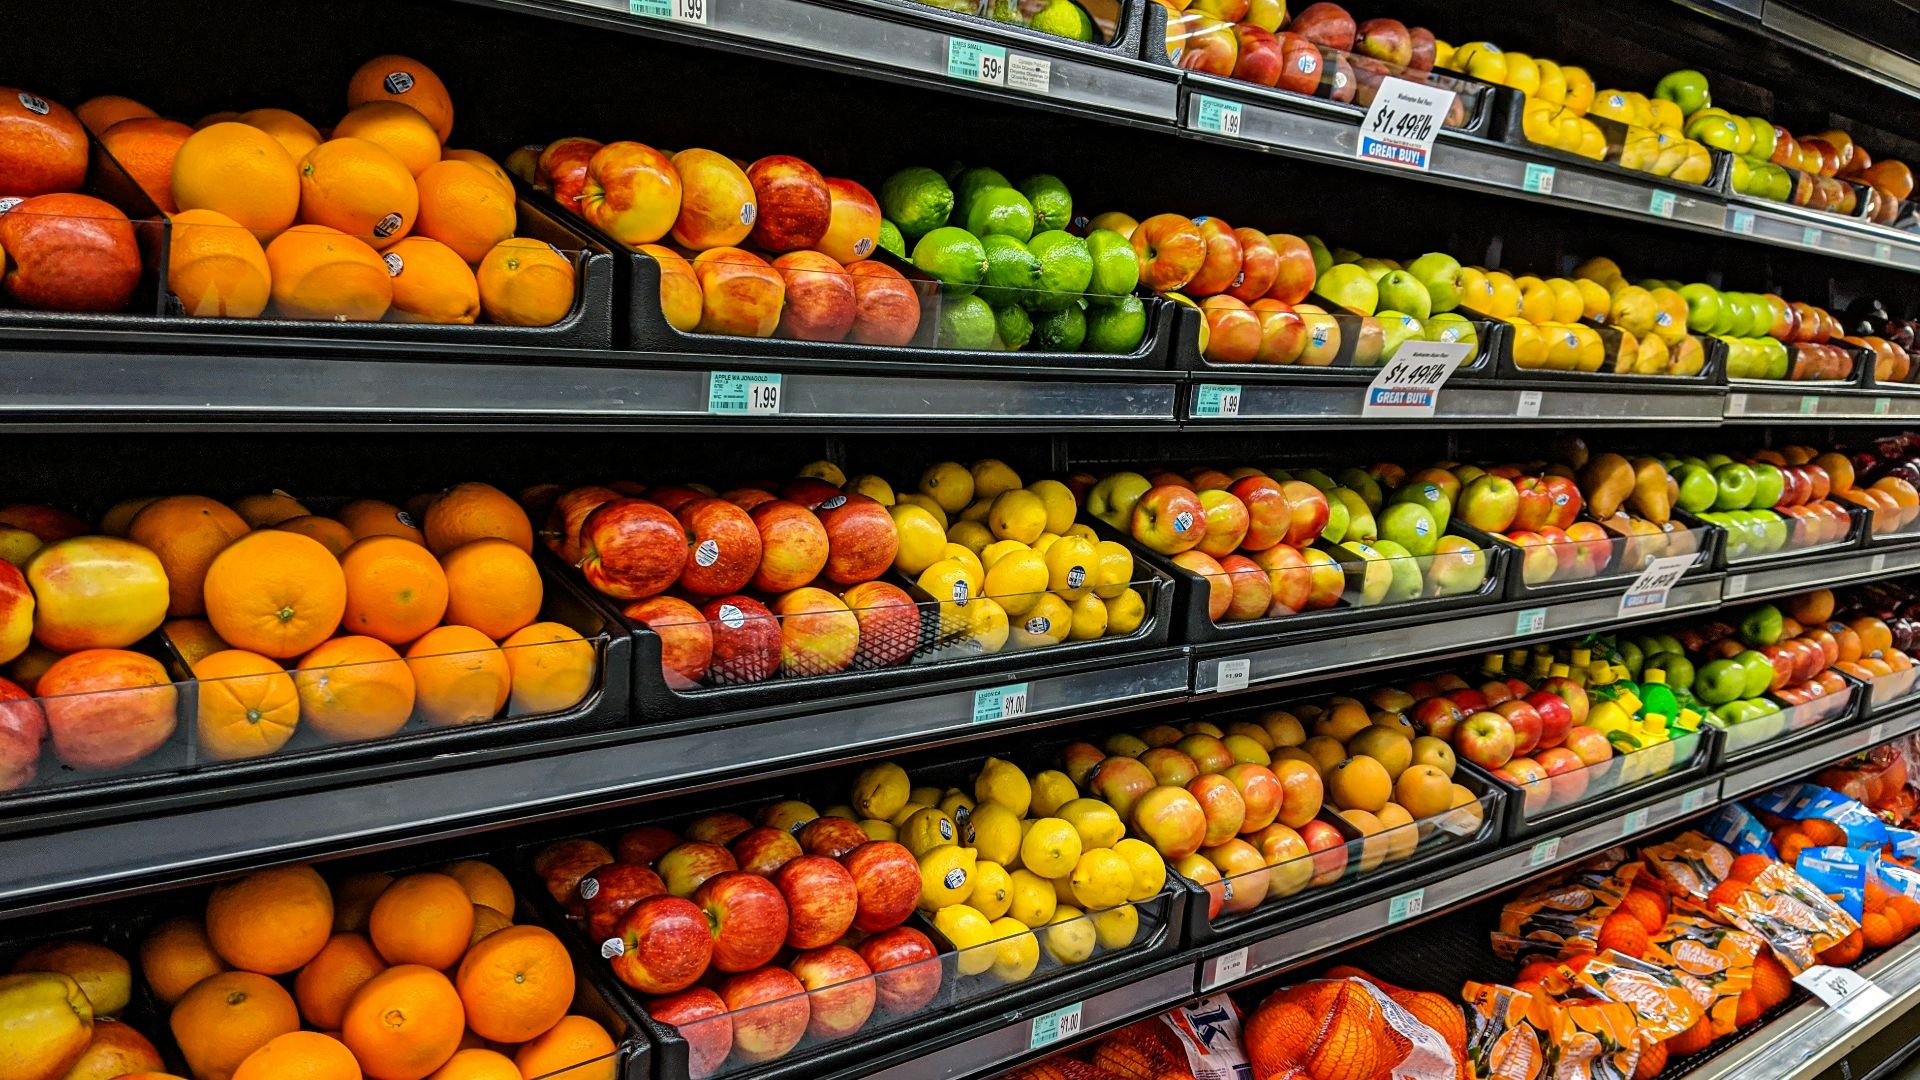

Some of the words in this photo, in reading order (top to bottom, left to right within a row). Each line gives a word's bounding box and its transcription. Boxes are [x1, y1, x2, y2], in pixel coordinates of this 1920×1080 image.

[679, 0, 703, 19] 1.99
[1224, 112, 1238, 133] 1.99
[1373, 104, 1418, 137] $1.49
[1368, 142, 1399, 159] GREAT
[1398, 149, 1421, 164] BUY!
[1384, 362, 1430, 384] $1.49
[754, 386, 777, 409] 1.99
[1224, 395, 1238, 413] 1.99
[1376, 392, 1406, 404] GREAT
[1406, 392, 1427, 404] BUY!
